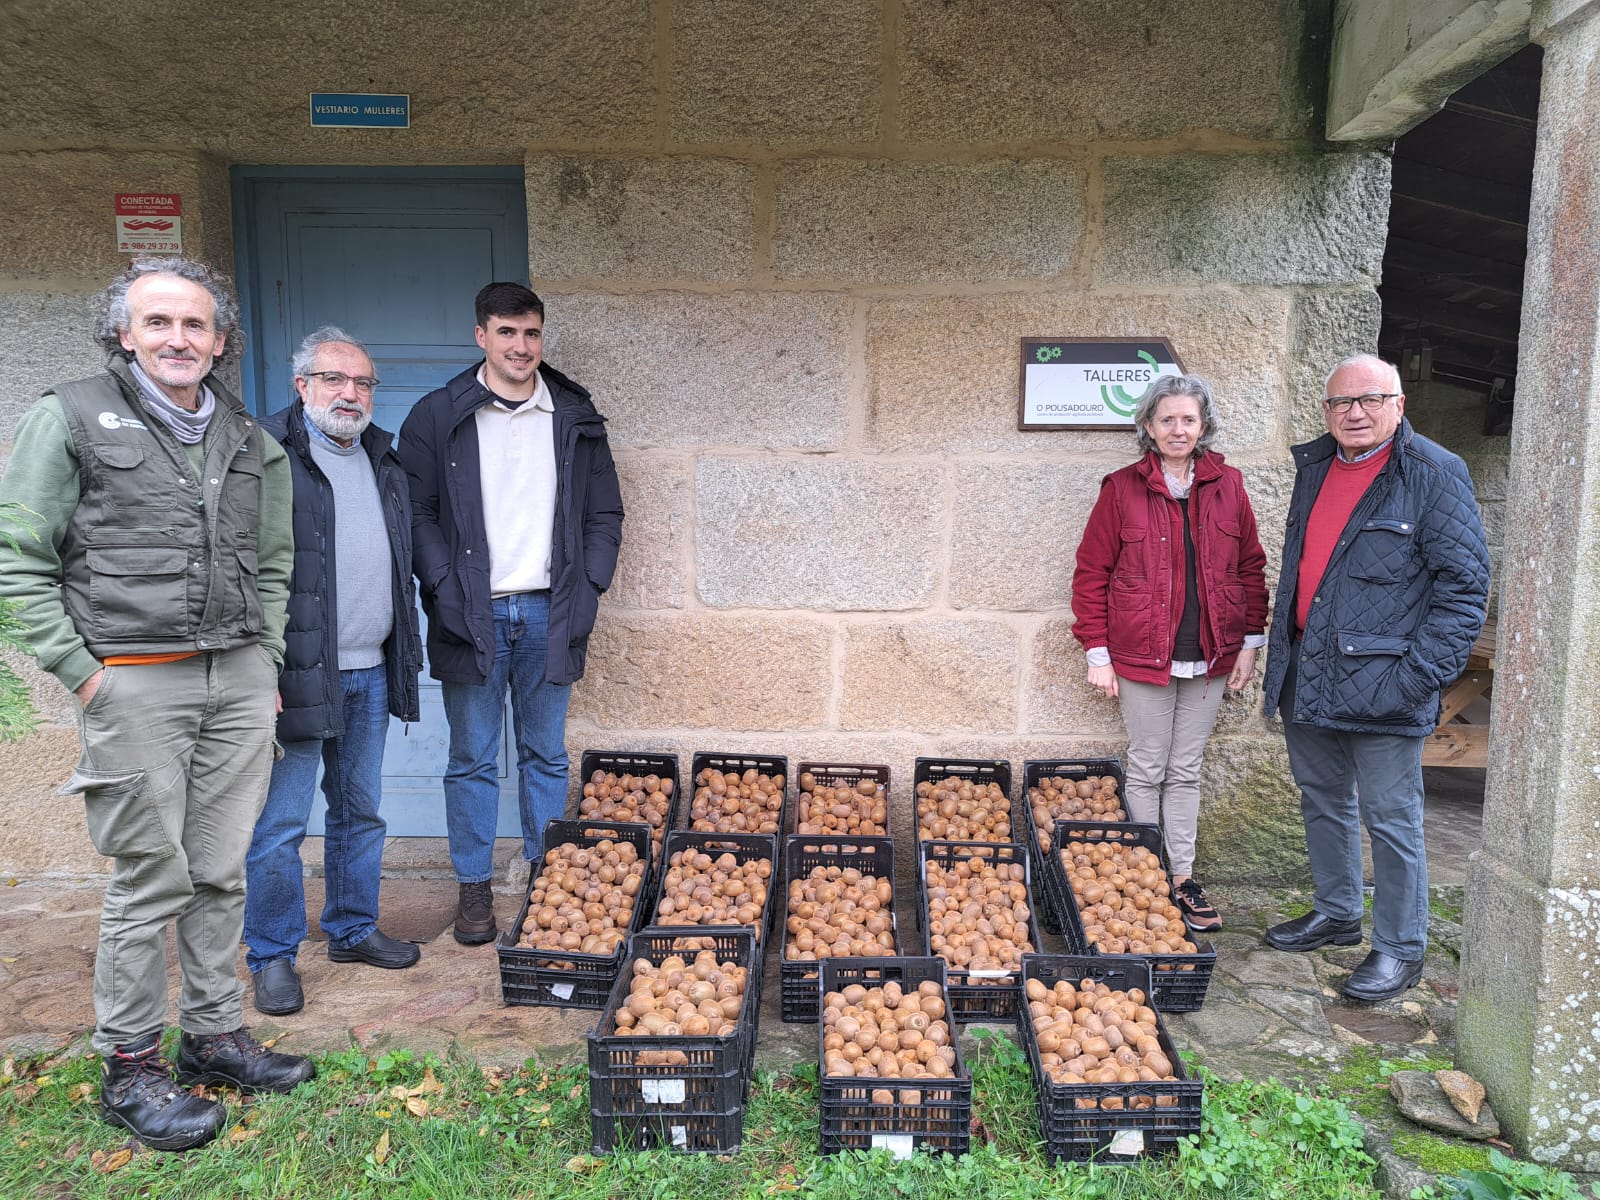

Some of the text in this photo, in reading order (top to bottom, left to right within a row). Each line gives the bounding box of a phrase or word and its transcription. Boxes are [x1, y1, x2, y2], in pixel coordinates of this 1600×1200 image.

[315, 105, 405, 115] VESTIARIO MULLERES
[120, 196, 173, 205] CONECTADA
[147, 242, 157, 250] 29
[158, 242, 168, 250] 37
[169, 242, 179, 250] 39
[1083, 369, 1151, 382] TALLERES
[1036, 404, 1104, 412] O POUSADOURO
